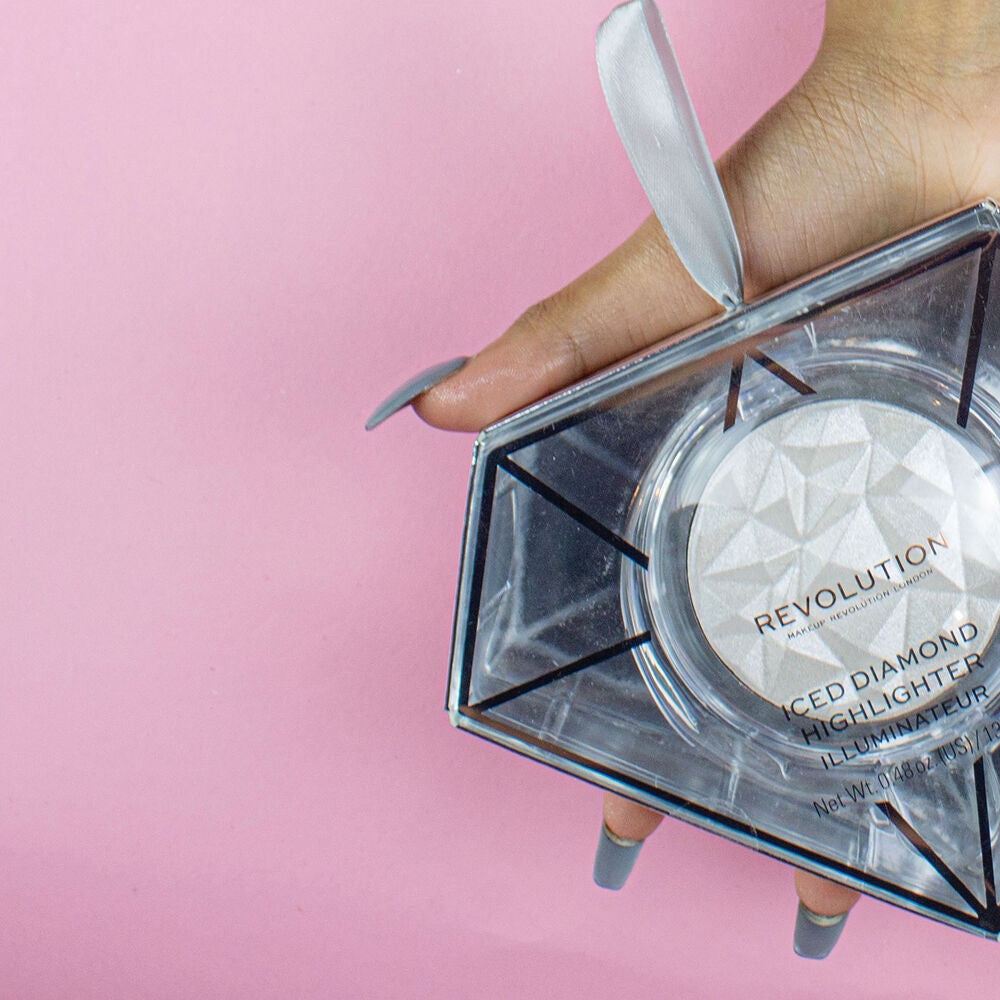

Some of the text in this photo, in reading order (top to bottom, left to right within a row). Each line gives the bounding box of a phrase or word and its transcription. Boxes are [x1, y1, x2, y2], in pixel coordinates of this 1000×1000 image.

[753, 531, 949, 635] REVOLUTION
[787, 568, 934, 641] MAKEUP REVOLUTION LONDON
[781, 622, 978, 722] ICED DIAMOND
[801, 652, 985, 746] HIGHLIGHTER
[821, 684, 990, 771] ILLUMINATEUR
[812, 792, 845, 819] Net
[846, 779, 879, 802] Wt.
[878, 761, 915, 791] 0.48
[937, 732, 976, 768] (US)
